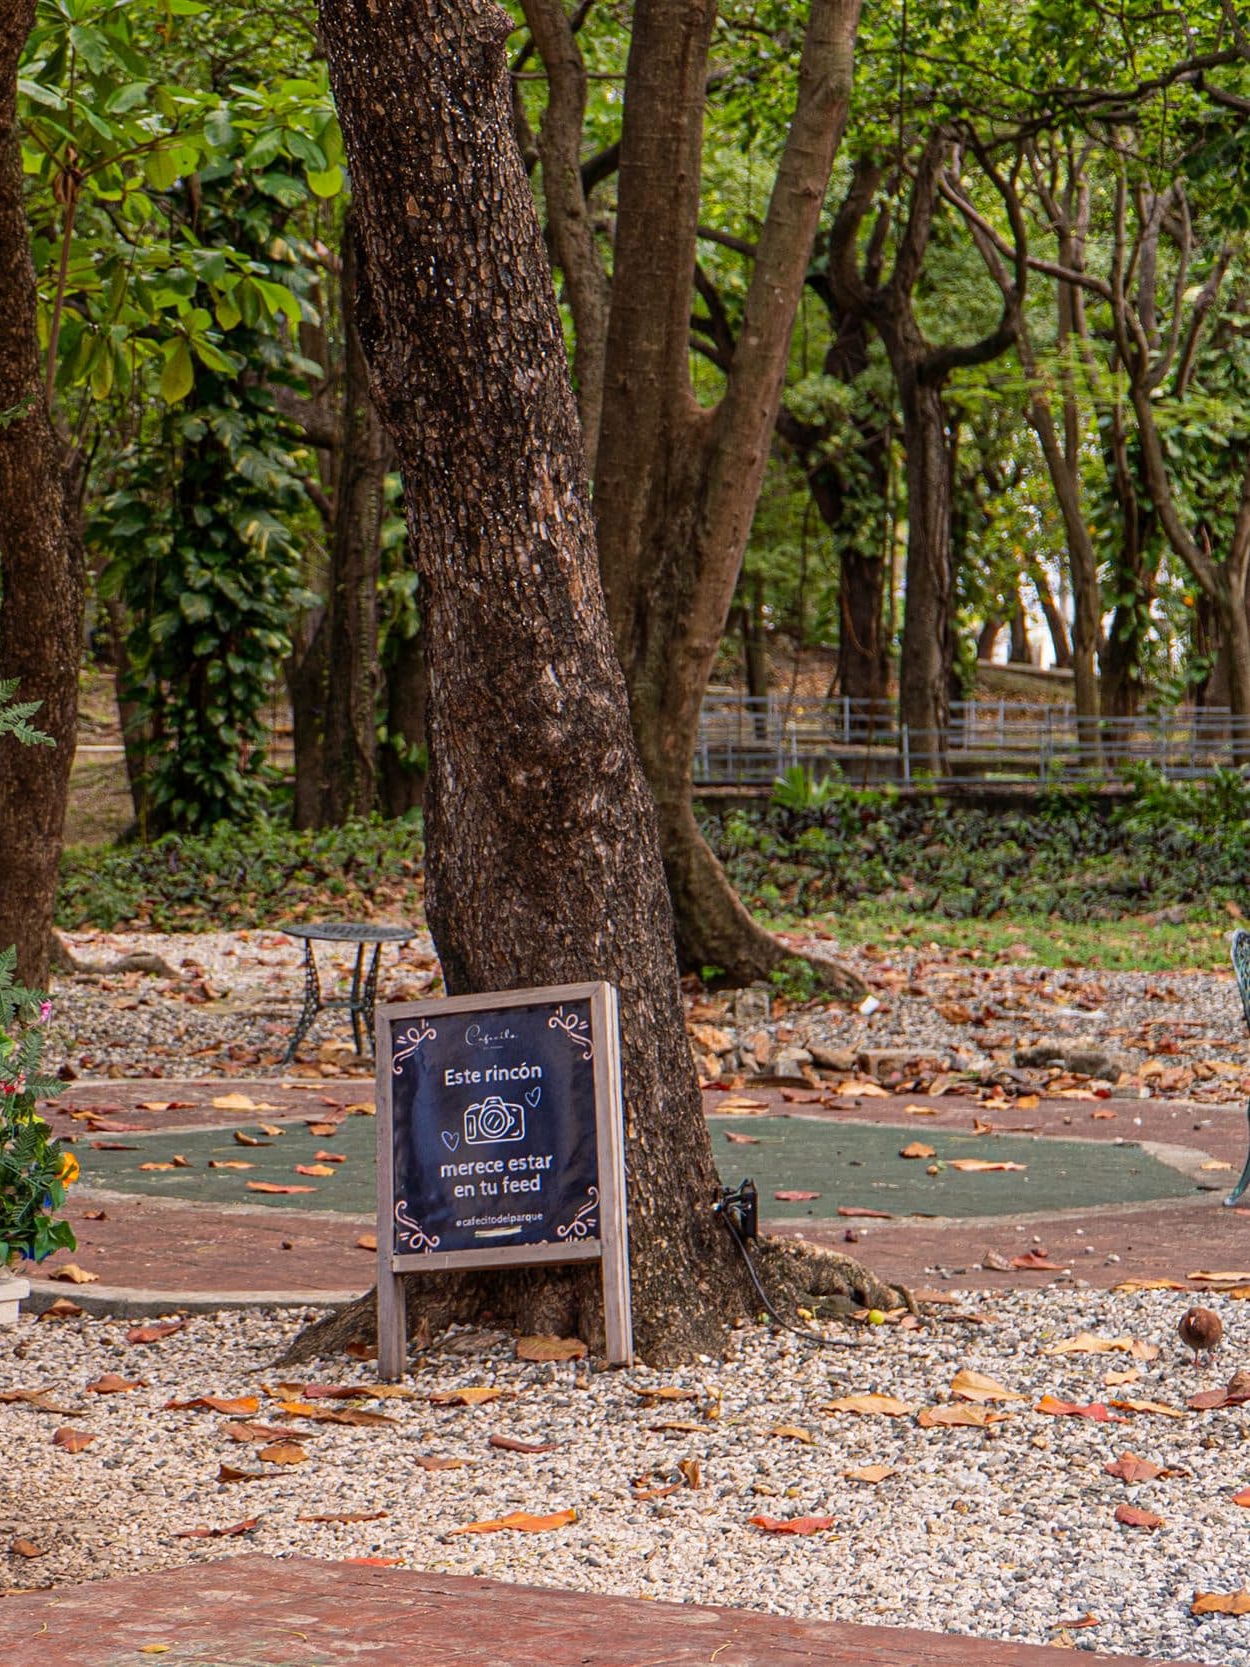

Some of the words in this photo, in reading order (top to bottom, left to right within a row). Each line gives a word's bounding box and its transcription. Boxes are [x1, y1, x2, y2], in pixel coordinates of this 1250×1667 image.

[444, 1067, 481, 1086] Este
[485, 1062, 542, 1083] rincón
[440, 1159, 504, 1178] merece
[508, 1154, 553, 1172] estar
[454, 1184, 475, 1198] en
[479, 1180, 498, 1196] tu
[502, 1174, 541, 1194] feed
